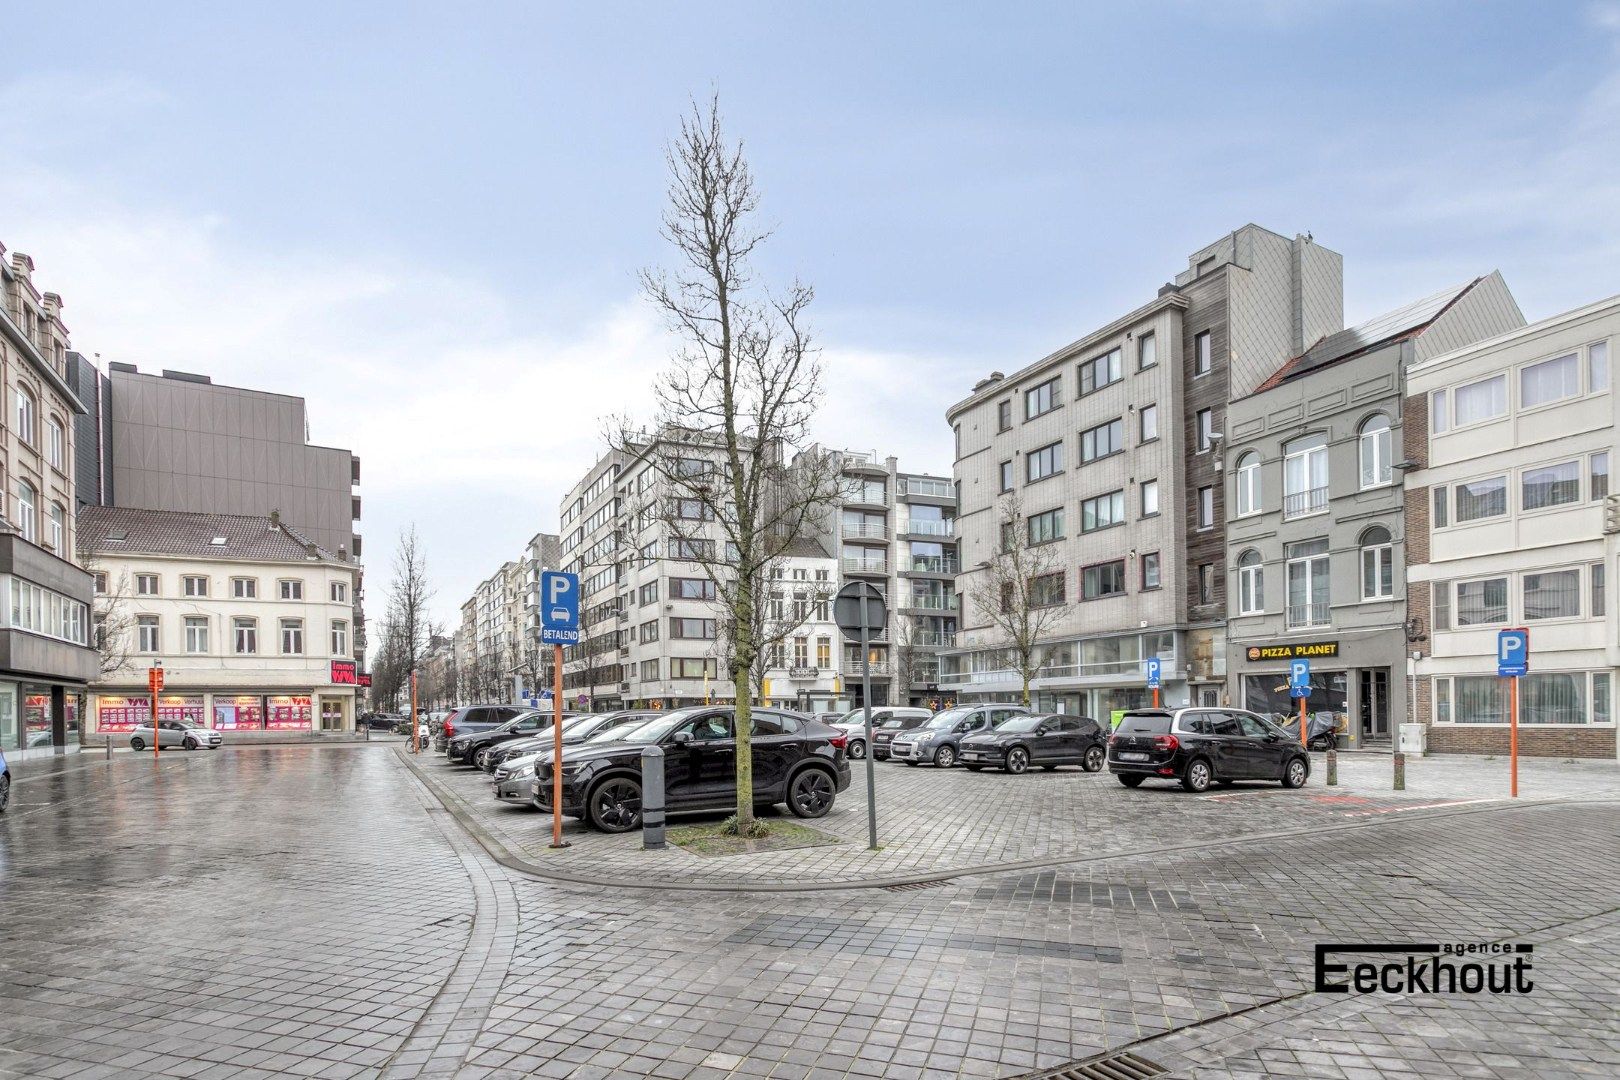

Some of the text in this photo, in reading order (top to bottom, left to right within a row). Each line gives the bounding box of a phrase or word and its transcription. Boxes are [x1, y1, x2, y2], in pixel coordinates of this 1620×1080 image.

[550, 575, 571, 604] P
[543, 629, 578, 640] BETALEND
[1261, 644, 1336, 658] PIZZA PLANET
[1501, 636, 1522, 660] P
[1149, 662, 1158, 677] P
[1293, 663, 1307, 683] P
